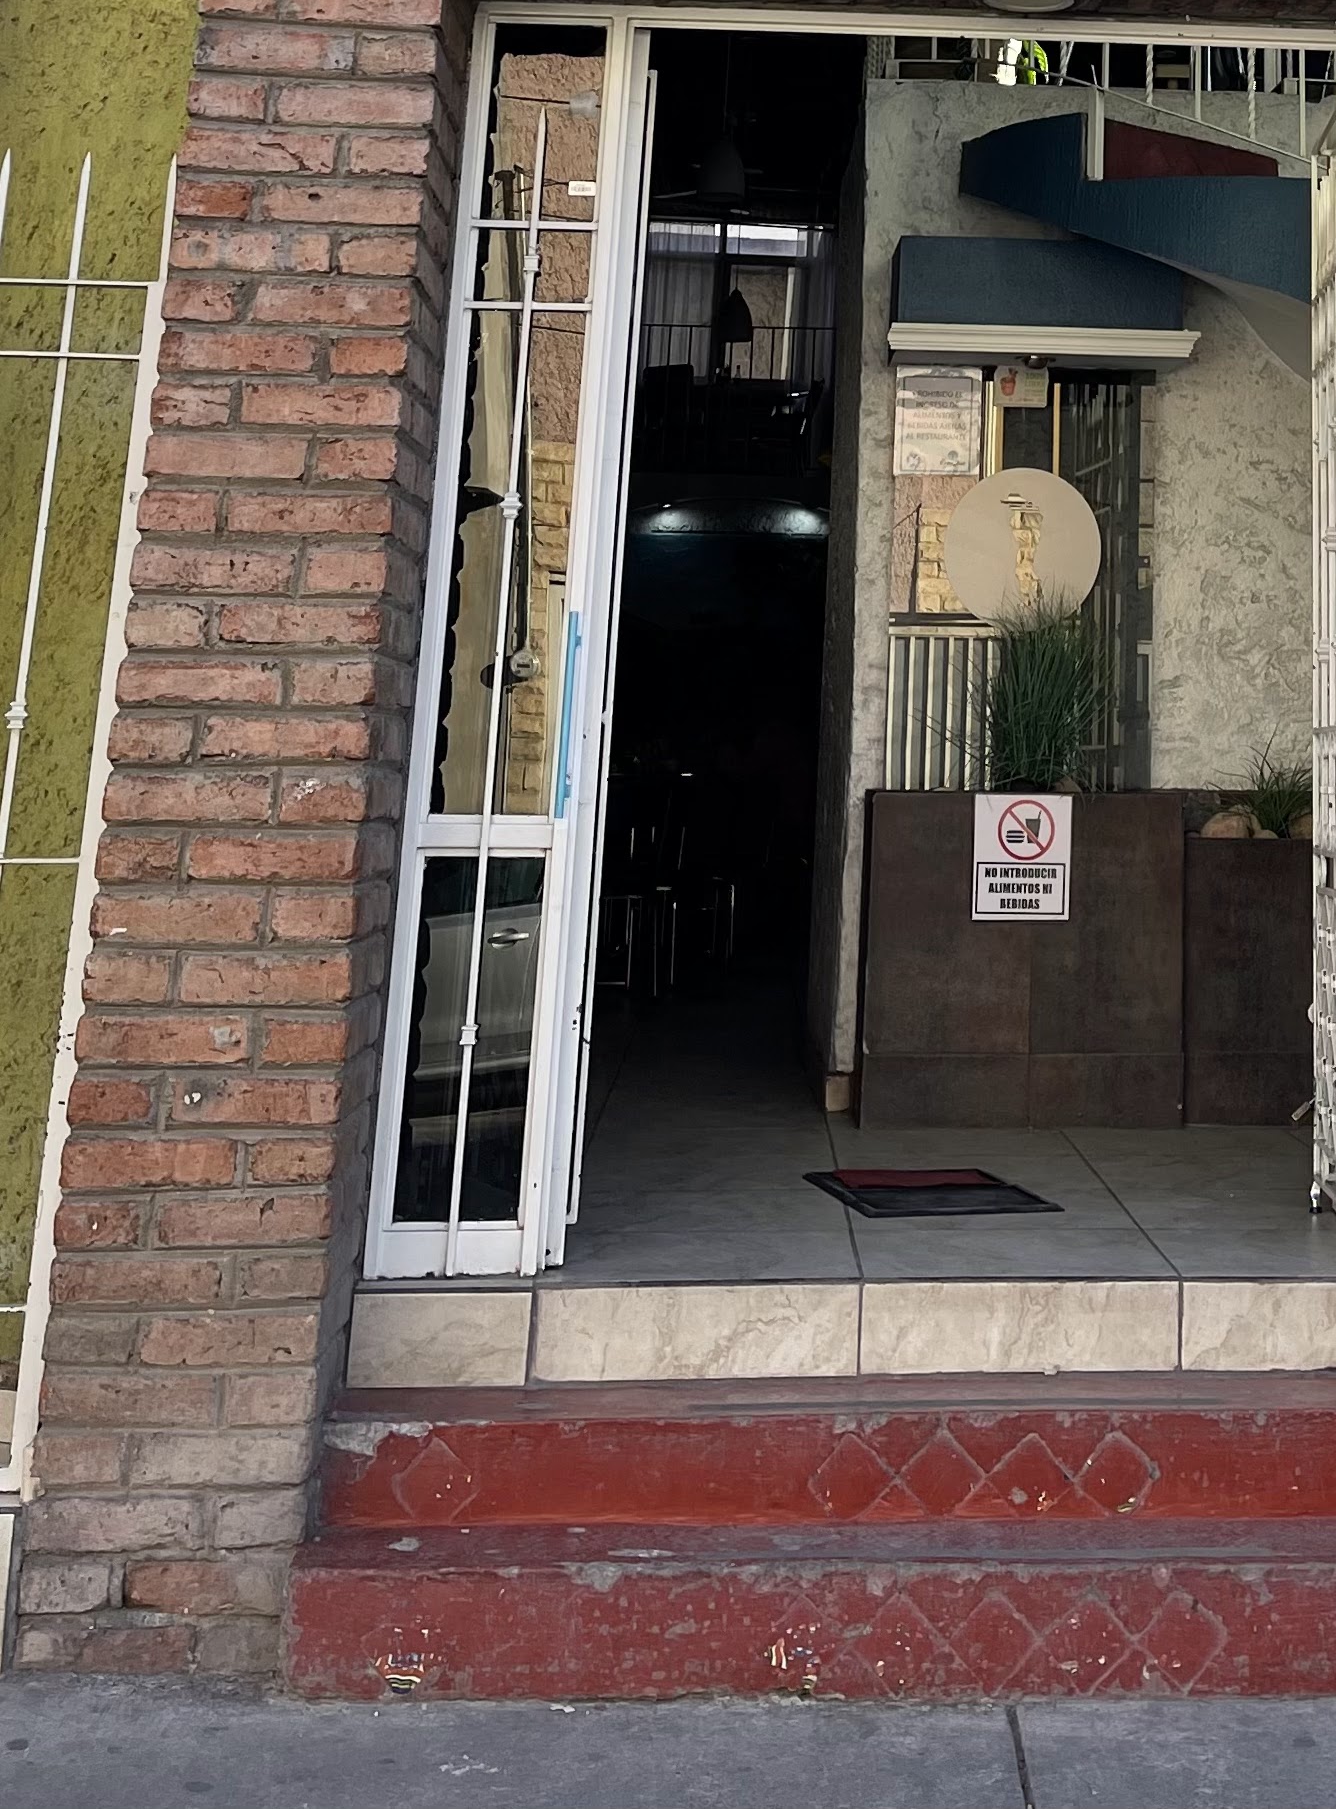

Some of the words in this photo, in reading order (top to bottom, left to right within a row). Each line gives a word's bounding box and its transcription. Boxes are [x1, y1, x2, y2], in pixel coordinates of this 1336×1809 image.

[984, 867, 998, 878] NO
[999, 867, 1057, 879] INTRODUCIR
[988, 882, 1040, 894] ALIMENTOS
[1042, 883, 1053, 895] NI
[999, 898, 1040, 910] BEBIDAS
